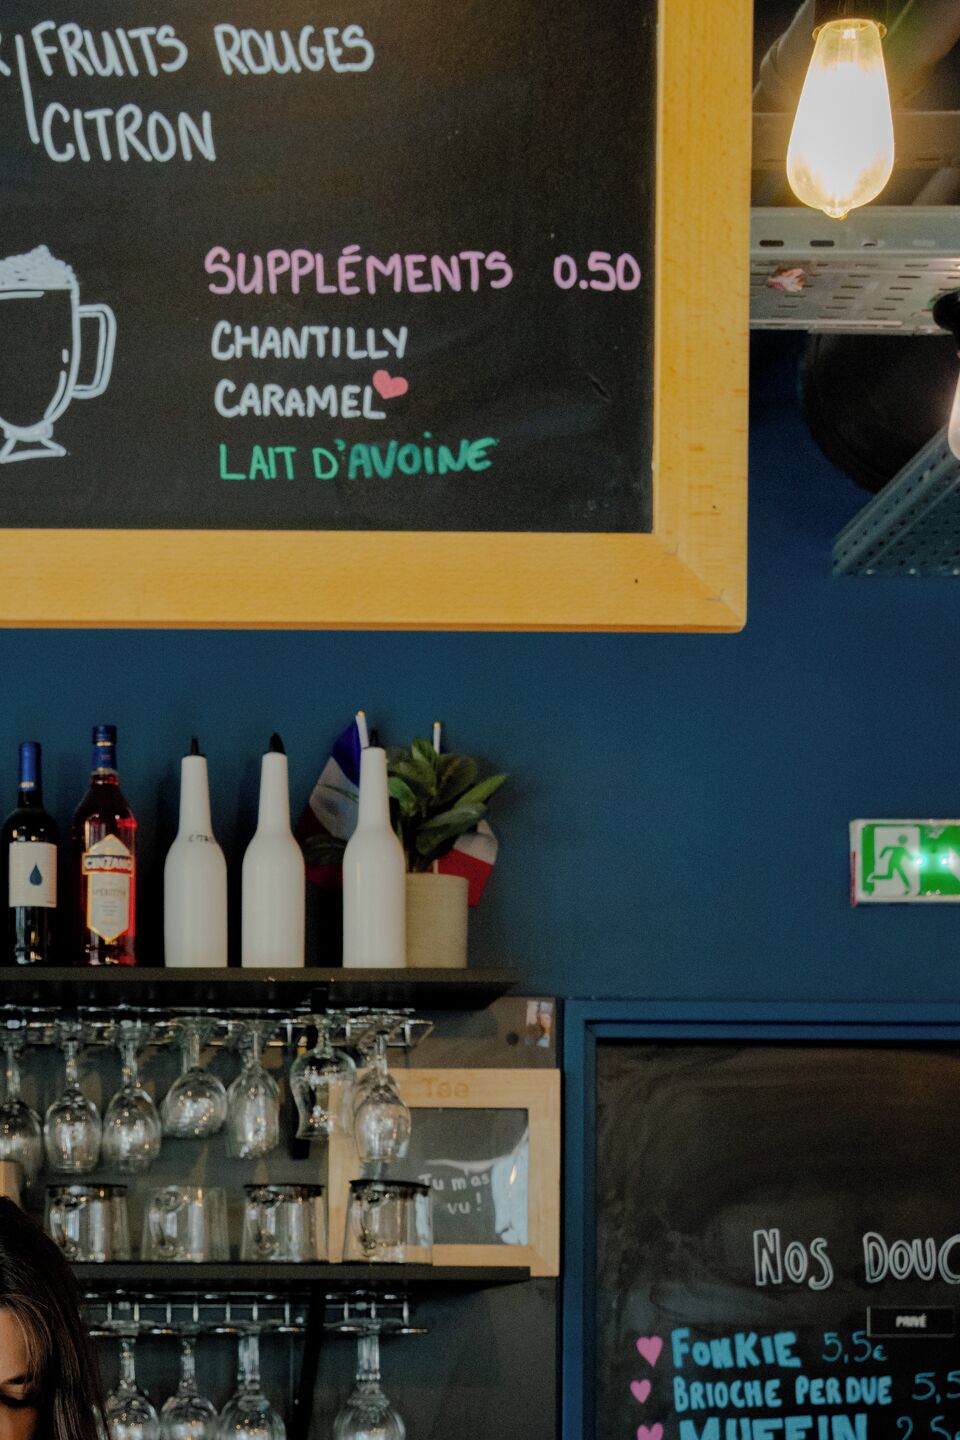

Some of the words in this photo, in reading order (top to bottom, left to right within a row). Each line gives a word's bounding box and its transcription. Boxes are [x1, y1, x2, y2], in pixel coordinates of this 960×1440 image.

[32, 16, 188, 77] FRUITS
[214, 24, 375, 76] ROUGES
[42, 102, 216, 162] CITRON
[204, 244, 514, 295] SUPPLÉMENTS
[553, 252, 641, 291] 0.50
[211, 320, 408, 361] CHANTILLY
[214, 378, 386, 420] CARAMEL
[219, 444, 297, 480] LAIT
[418, 1172, 444, 1191] Tu
[671, 1328, 801, 1369] FONKIE
[673, 1375, 783, 1412] BRIOCHE
[795, 1375, 892, 1405] PERDUE
